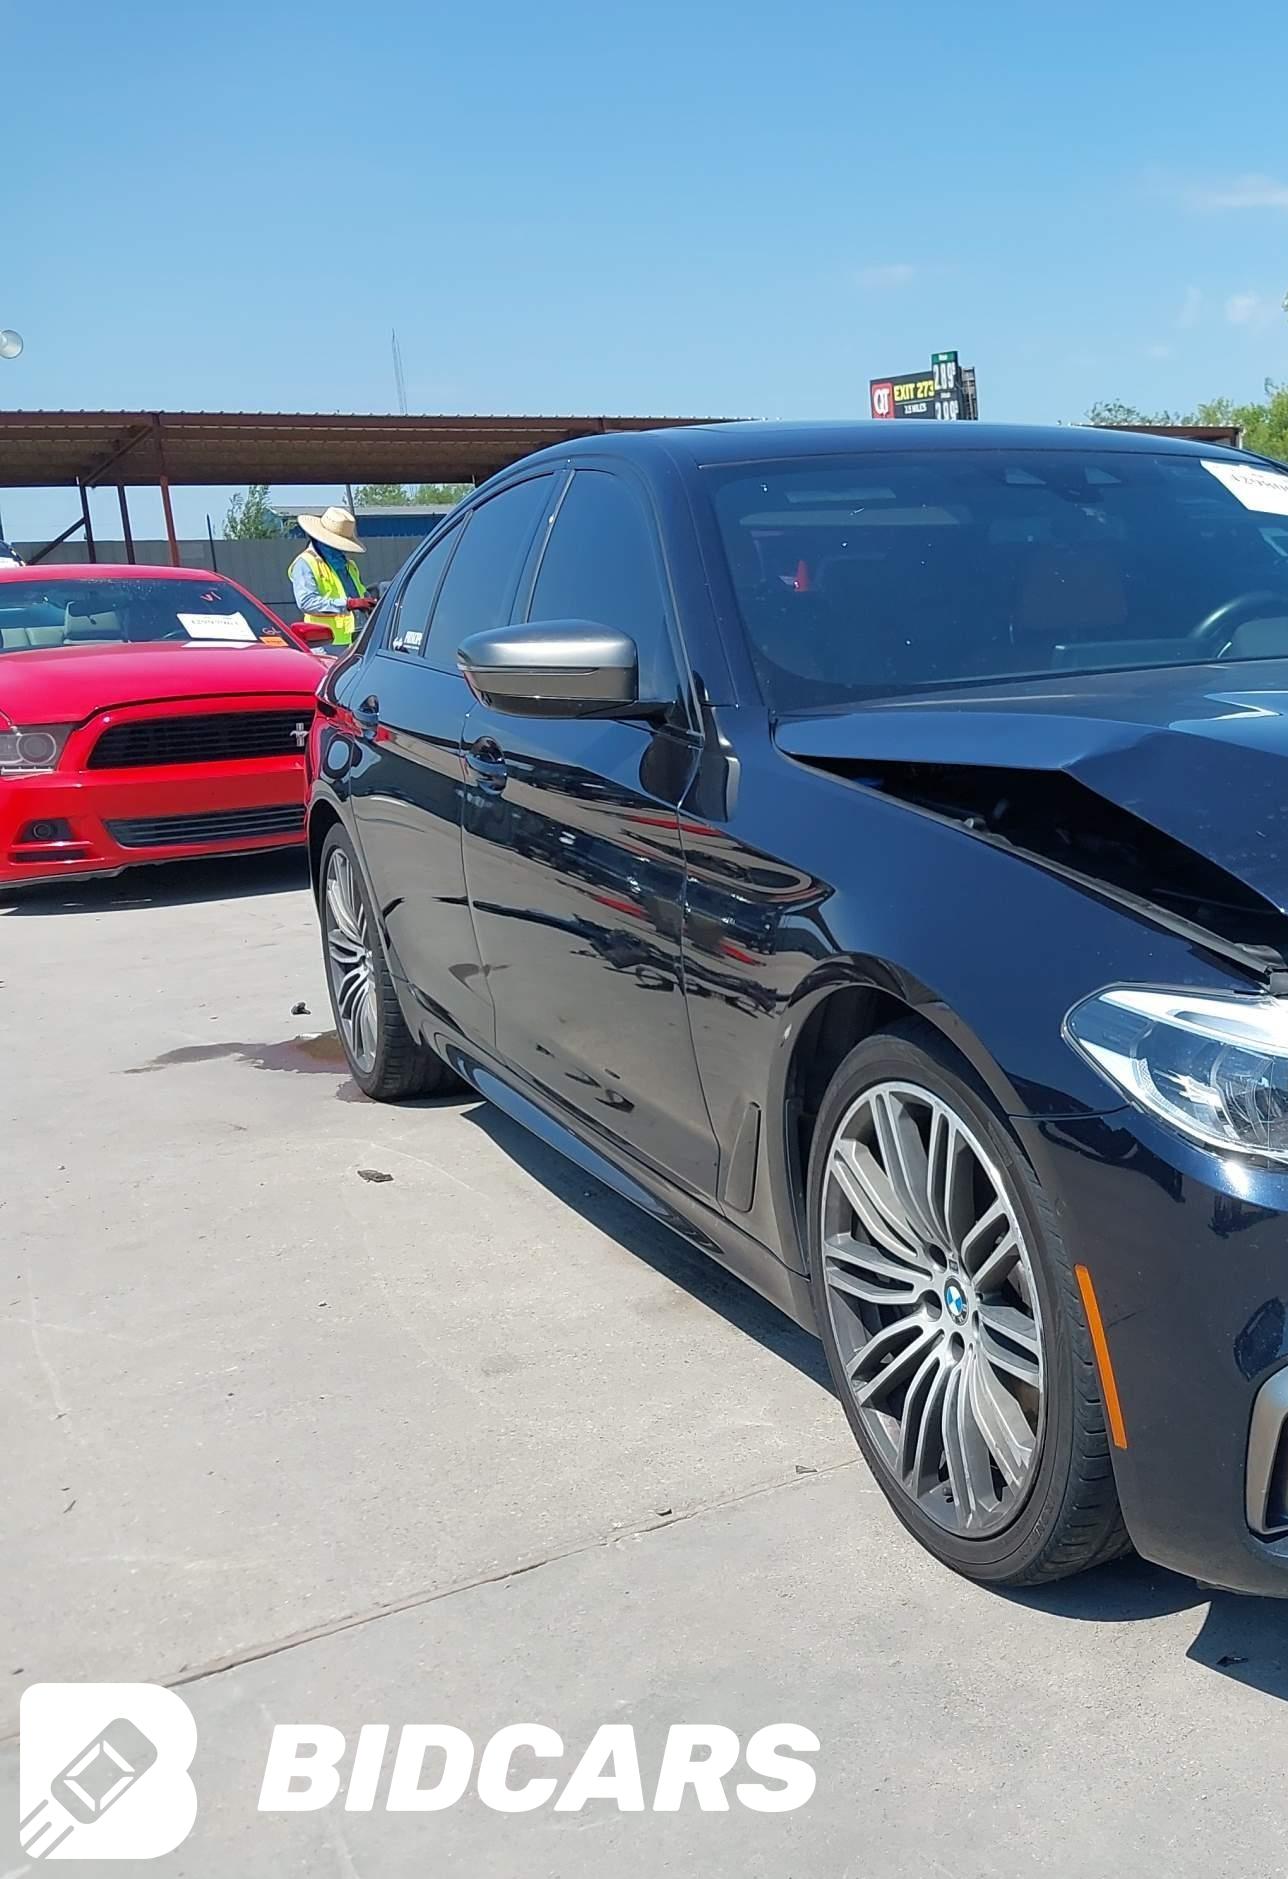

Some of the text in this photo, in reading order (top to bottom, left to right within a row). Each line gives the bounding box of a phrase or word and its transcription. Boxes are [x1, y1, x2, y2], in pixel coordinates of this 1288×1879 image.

[873, 388, 890, 417] QT
[893, 380, 935, 401] EXIT 273
